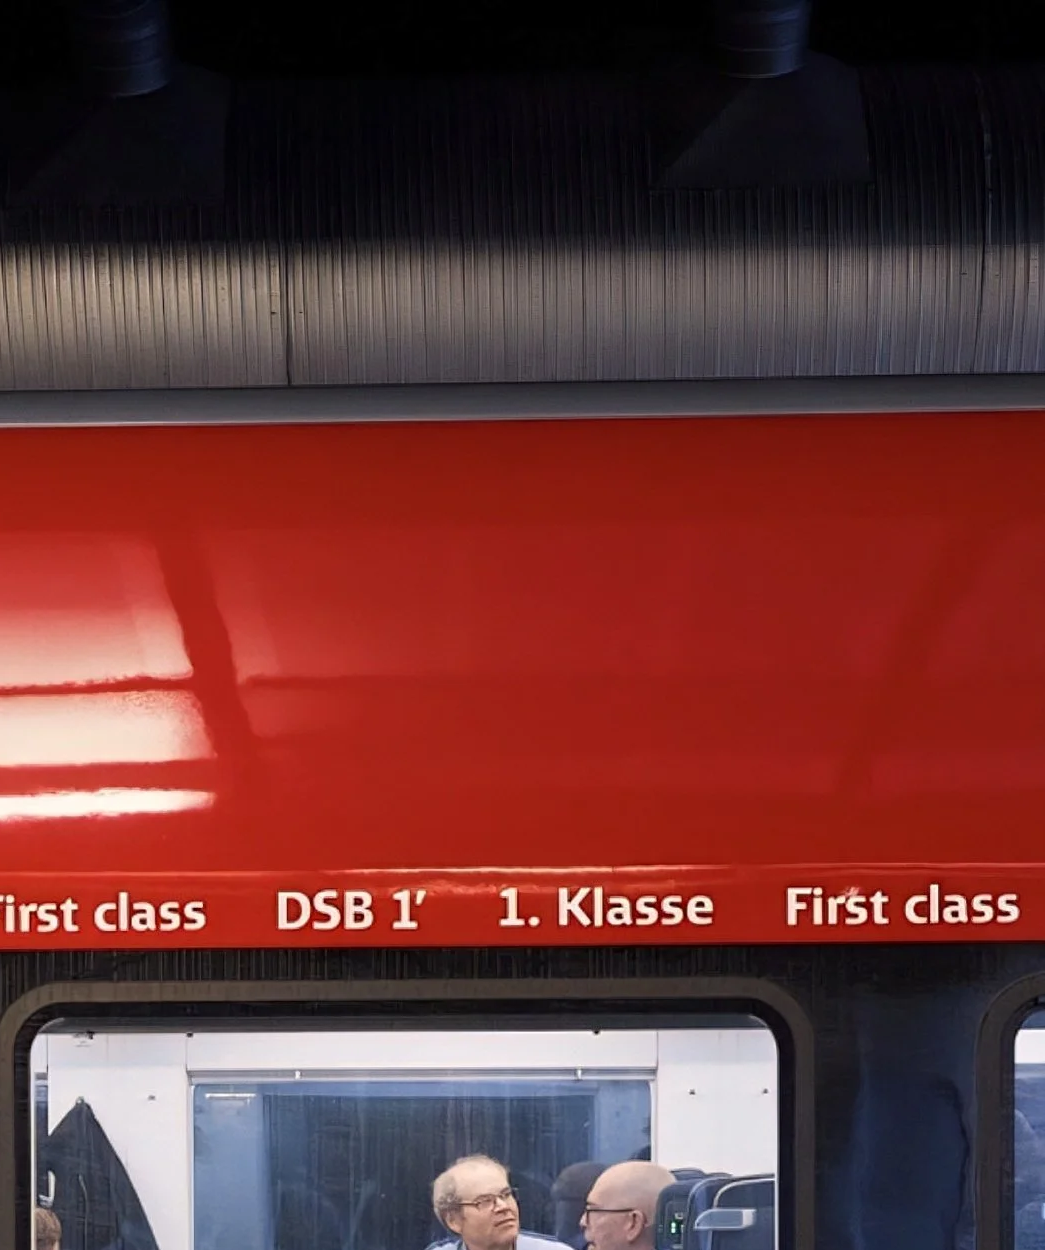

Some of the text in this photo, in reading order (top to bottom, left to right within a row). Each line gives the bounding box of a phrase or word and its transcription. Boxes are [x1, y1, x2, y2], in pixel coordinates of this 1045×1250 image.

[94, 892, 207, 932] class
[277, 890, 374, 930] DSB
[499, 886, 714, 927] 1. Klasse
[786, 883, 1020, 925] First class
